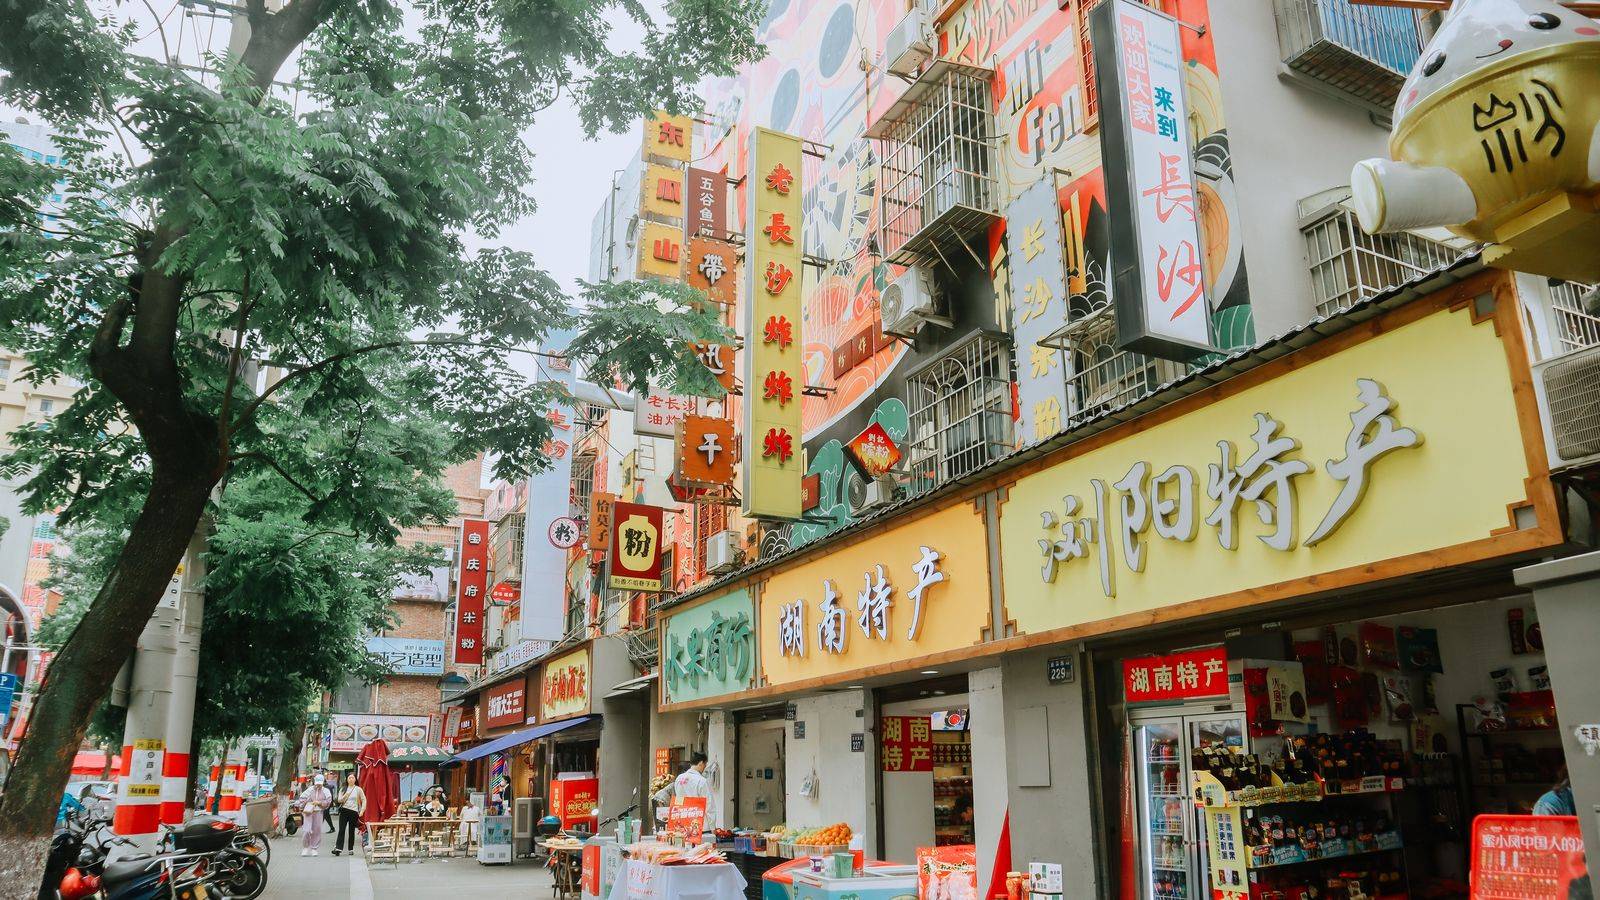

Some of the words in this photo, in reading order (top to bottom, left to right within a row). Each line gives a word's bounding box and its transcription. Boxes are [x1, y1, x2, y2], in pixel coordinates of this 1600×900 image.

[1121, 24, 1152, 124] 欢迎大家
[1154, 86, 1179, 142] 来到
[1142, 151, 1203, 321] 長沙
[763, 162, 793, 464] 老長沙炸炸炸
[648, 394, 696, 411] 老长沙
[1037, 378, 1425, 599] 浏阳特产
[554, 523, 575, 543] 粉
[624, 528, 651, 557] 粉
[778, 546, 945, 658] 湖南特产
[1051, 667, 1066, 680] 229
[1130, 658, 1223, 692] 湖南特产
[852, 741, 861, 750] 227
[882, 718, 930, 743] 湖南
[882, 747, 930, 772] 特产
